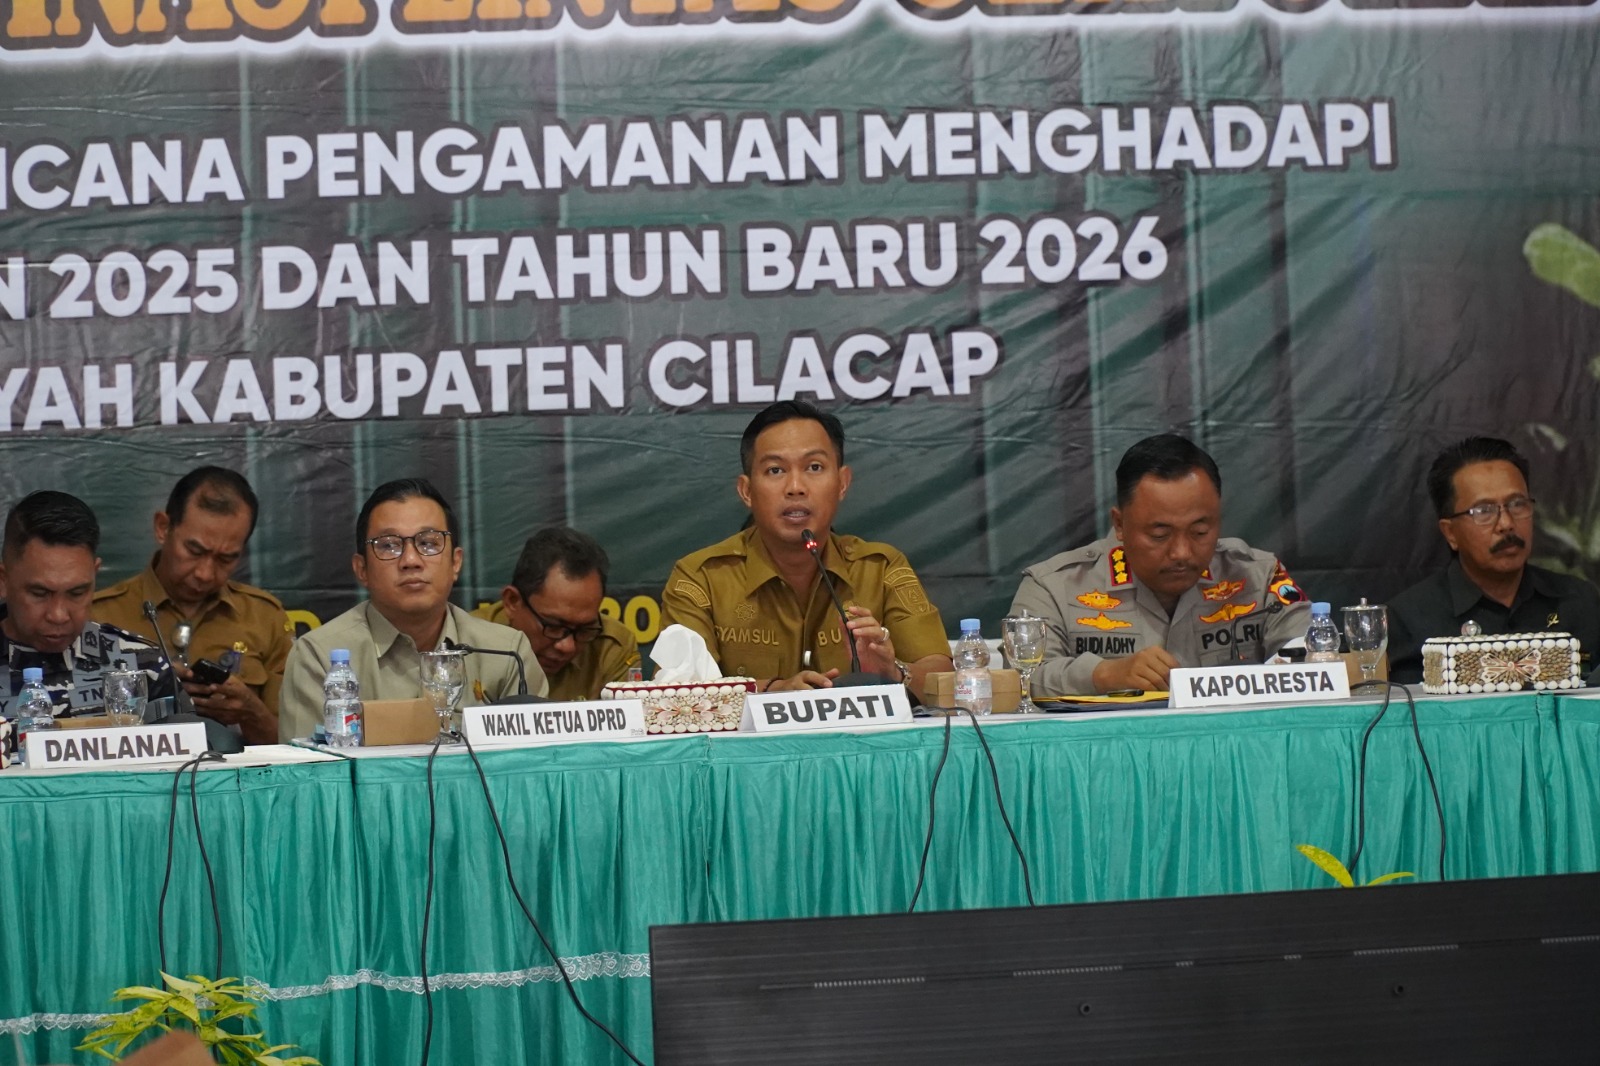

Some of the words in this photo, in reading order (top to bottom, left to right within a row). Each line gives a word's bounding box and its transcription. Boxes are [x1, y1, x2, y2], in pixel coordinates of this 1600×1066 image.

[0, 139, 244, 209] CANA
[267, 117, 838, 198] PENGAMANAN
[865, 104, 1390, 177] MENGHADAPI
[49, 249, 238, 317] 2025
[262, 241, 429, 309] DAN
[452, 231, 720, 301] TAHUN
[747, 223, 957, 290] BARU
[981, 217, 1168, 283] 2026
[160, 345, 623, 423] KABUPATEN
[649, 332, 997, 405] CILACAP
[1075, 637, 1104, 654] BUDI
[1105, 637, 1136, 654] ADHY
[1202, 624, 1261, 650] POLRI
[1190, 671, 1335, 698] KAPOLRESTA
[482, 713, 530, 736] WAKIL
[534, 711, 584, 734] KETUA
[587, 708, 627, 731] DPRD
[763, 695, 895, 724] BUPATI
[45, 733, 190, 762] DANLANAL
